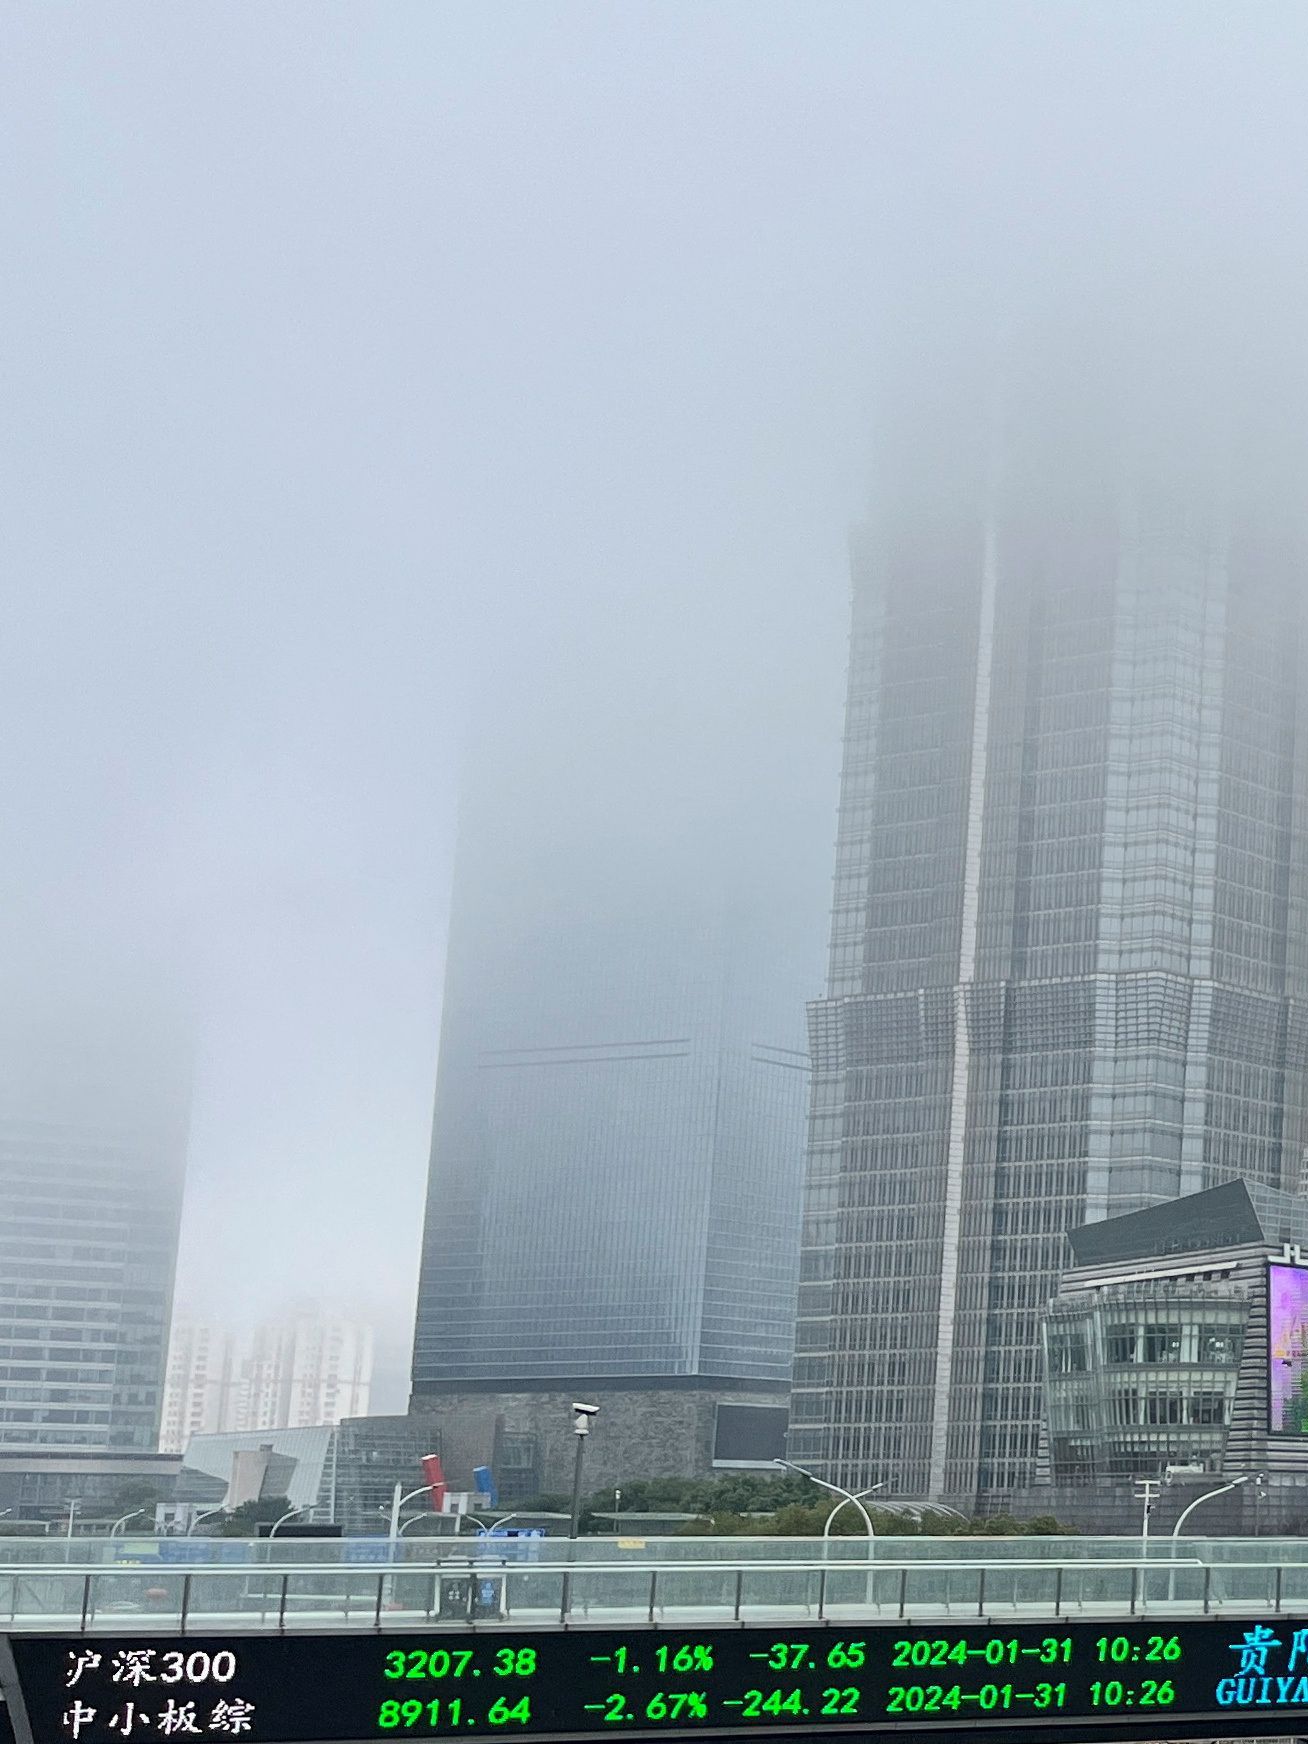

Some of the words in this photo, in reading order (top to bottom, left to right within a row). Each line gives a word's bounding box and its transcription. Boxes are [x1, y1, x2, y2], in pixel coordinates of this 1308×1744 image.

[65, 1649, 237, 1686] 沪深300
[384, 1648, 537, 1679] 3207.38
[590, 1645, 714, 1674] -1.16%
[749, 1641, 866, 1670] -37.65
[892, 1637, 1072, 1667] 2024-01-31
[1096, 1636, 1182, 1662] 10:26
[62, 1698, 256, 1740] 中小板综
[378, 1696, 531, 1728] 8911.64
[584, 1691, 708, 1721] -2.67%
[723, 1687, 861, 1717] -244.22
[886, 1682, 1066, 1712] 2024-01-31
[1089, 1680, 1175, 1706] 10:26
